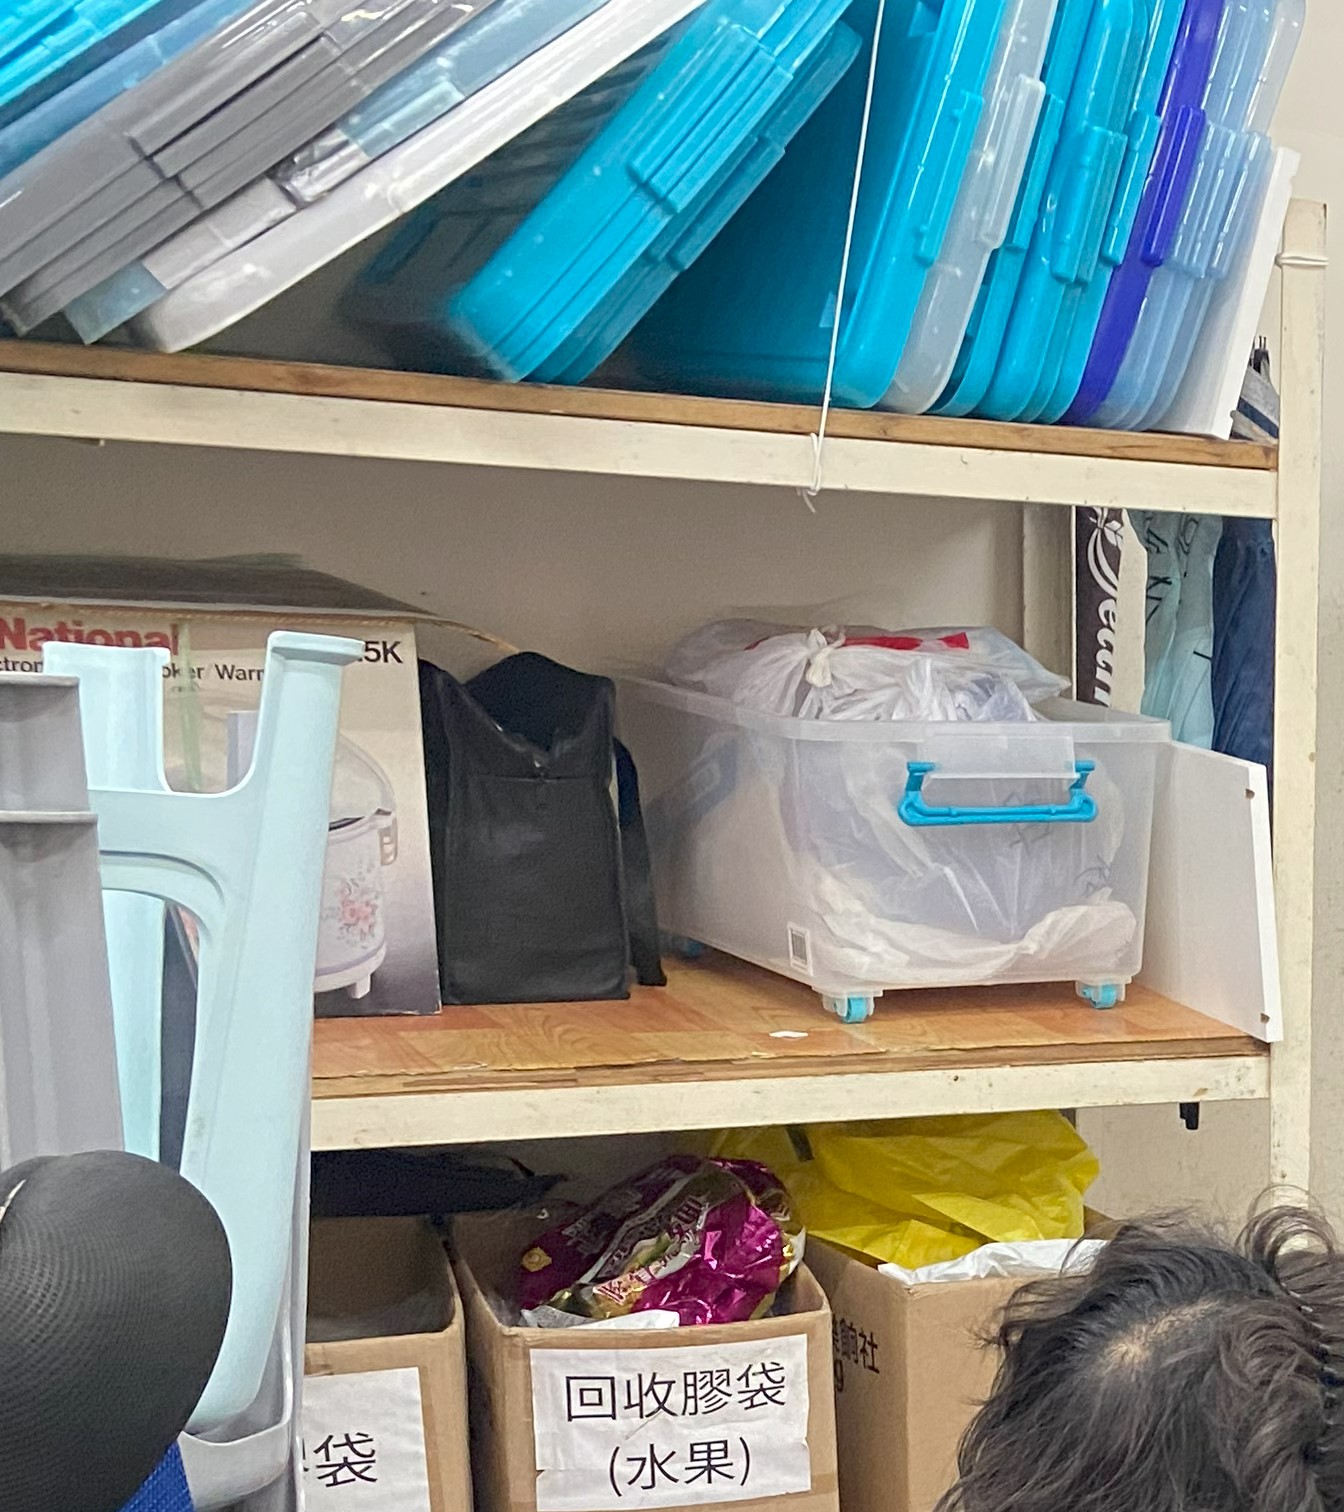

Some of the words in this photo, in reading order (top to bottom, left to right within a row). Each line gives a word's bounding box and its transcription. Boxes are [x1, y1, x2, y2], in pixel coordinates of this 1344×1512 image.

[565, 1362, 787, 1422] 回收膠袋
[300, 1431, 379, 1488] 袋
[609, 1437, 751, 1497] (水果)
